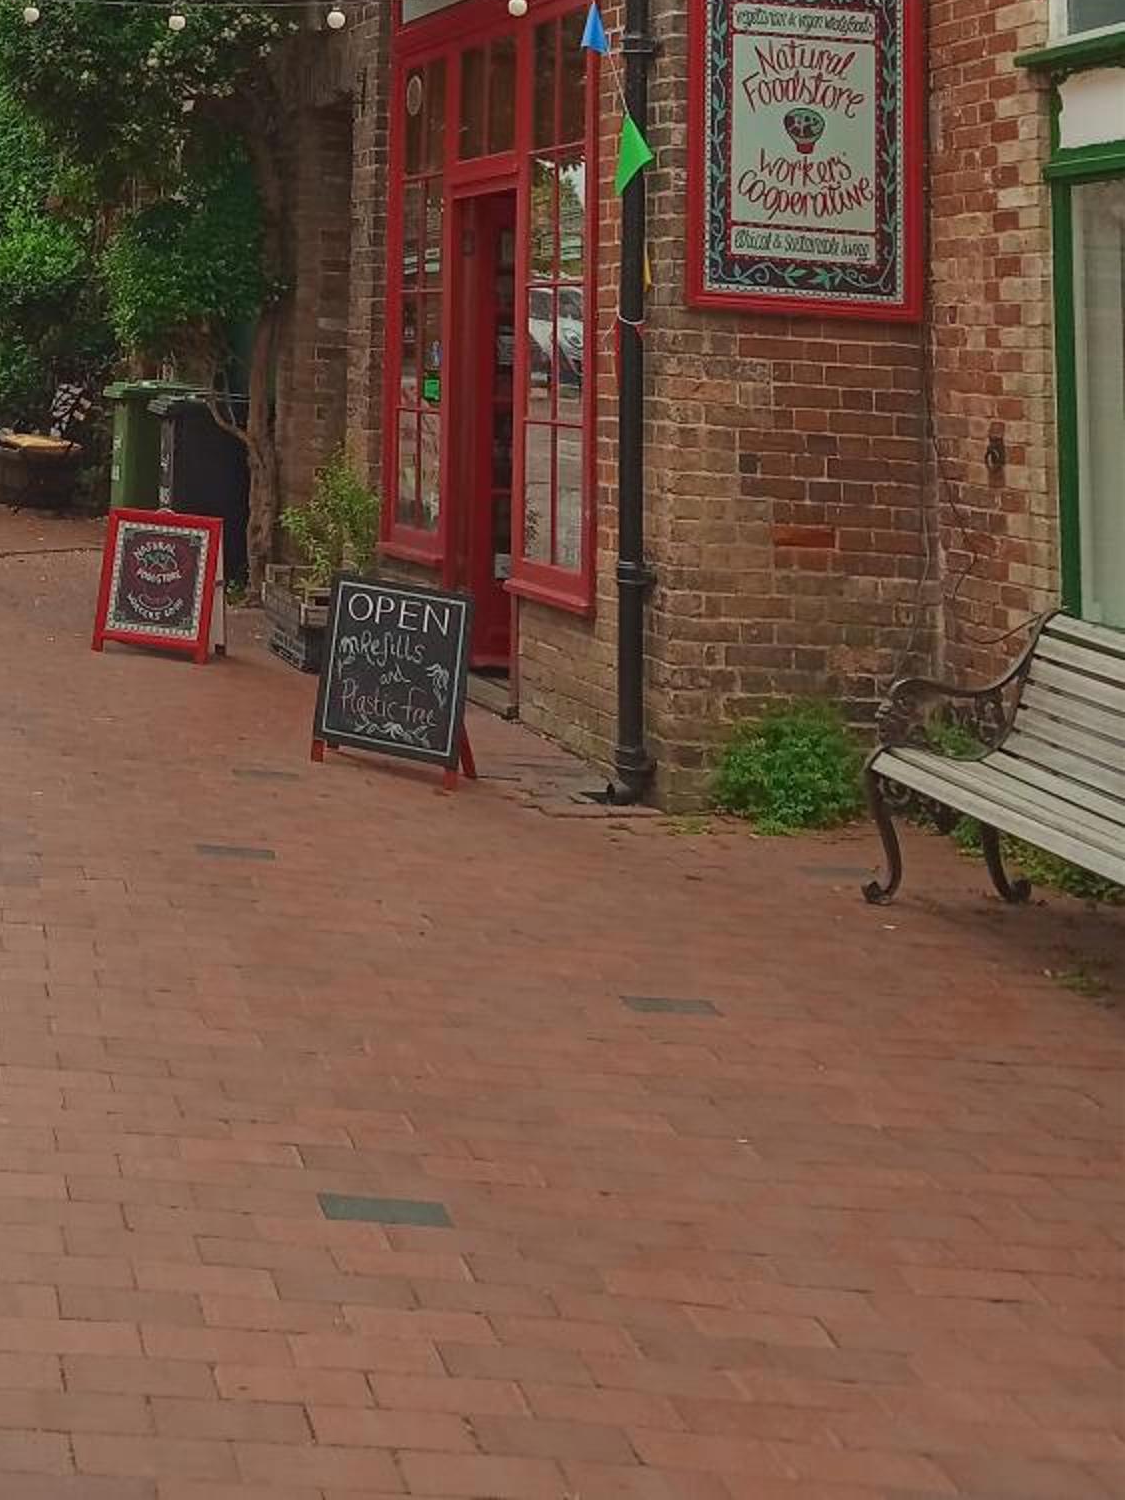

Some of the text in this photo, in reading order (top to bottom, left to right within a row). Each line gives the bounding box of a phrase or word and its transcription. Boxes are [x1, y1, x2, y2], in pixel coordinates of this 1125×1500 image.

[754, 39, 857, 81] Natural
[742, 70, 865, 119] Foodstore
[348, 592, 451, 636] OPEN
[380, 662, 412, 685] and
[341, 677, 397, 721] Plastic
